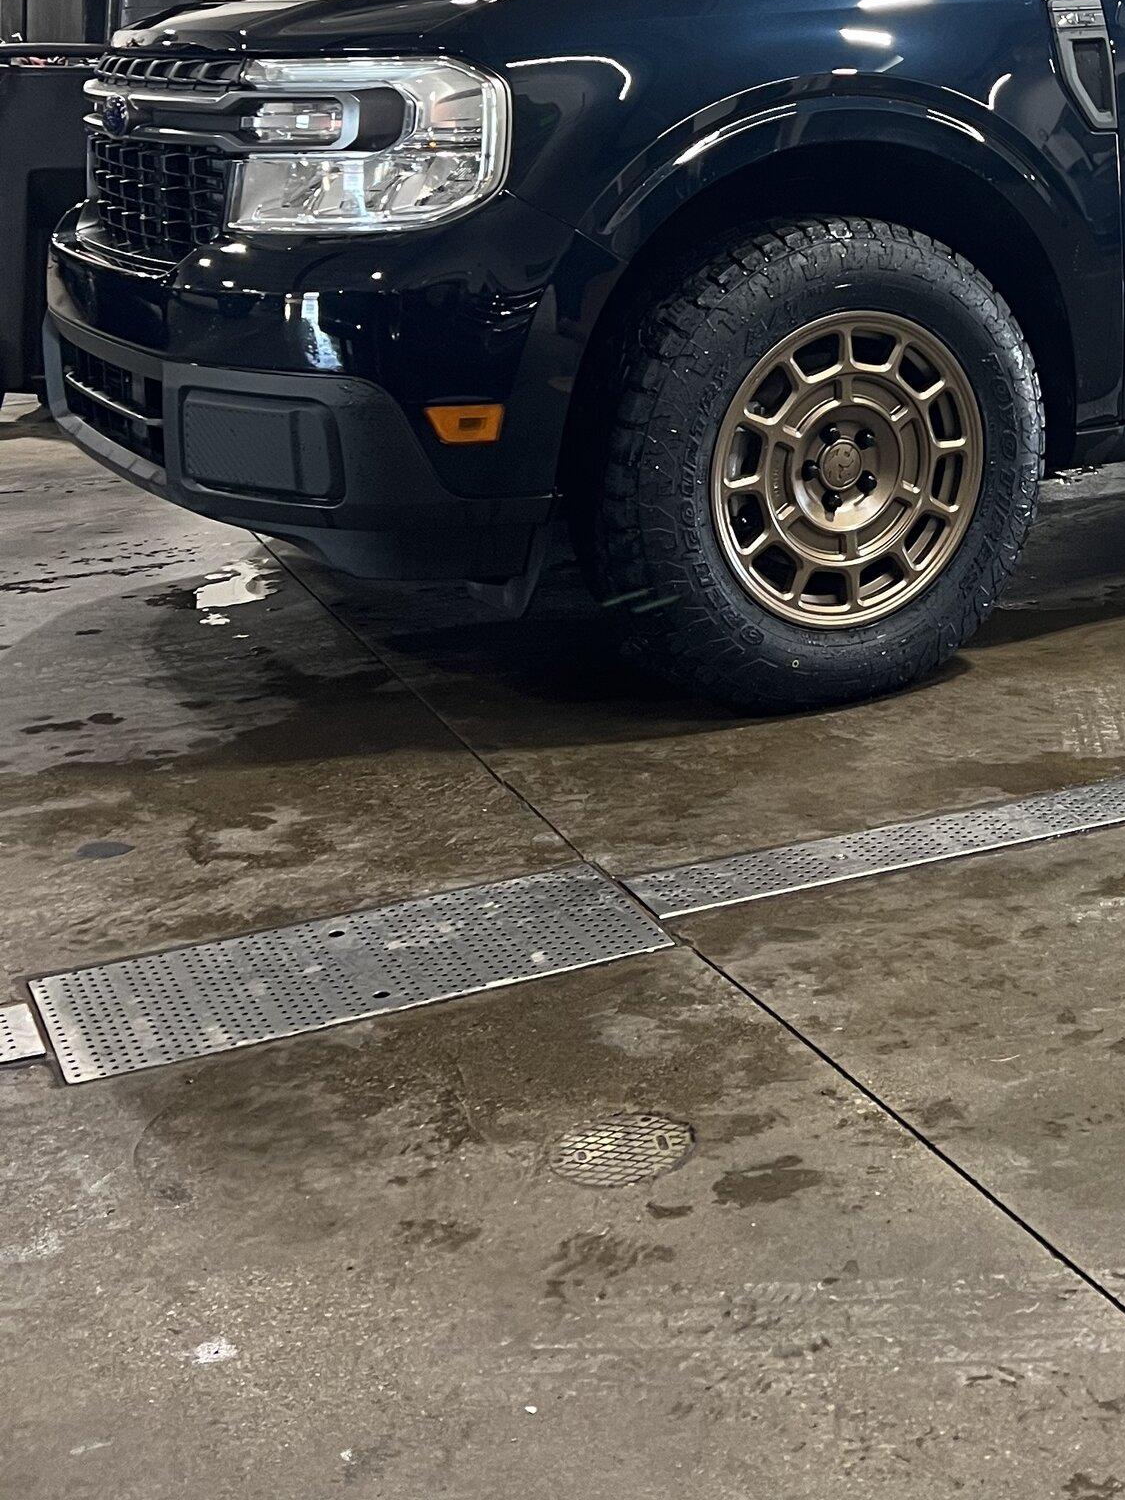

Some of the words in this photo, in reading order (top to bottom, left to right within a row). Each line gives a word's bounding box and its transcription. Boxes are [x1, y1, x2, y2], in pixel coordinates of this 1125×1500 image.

[680, 368, 731, 553] COUNTRY
[981, 352, 1018, 461] TOYO
[693, 562, 765, 645] OPEN
